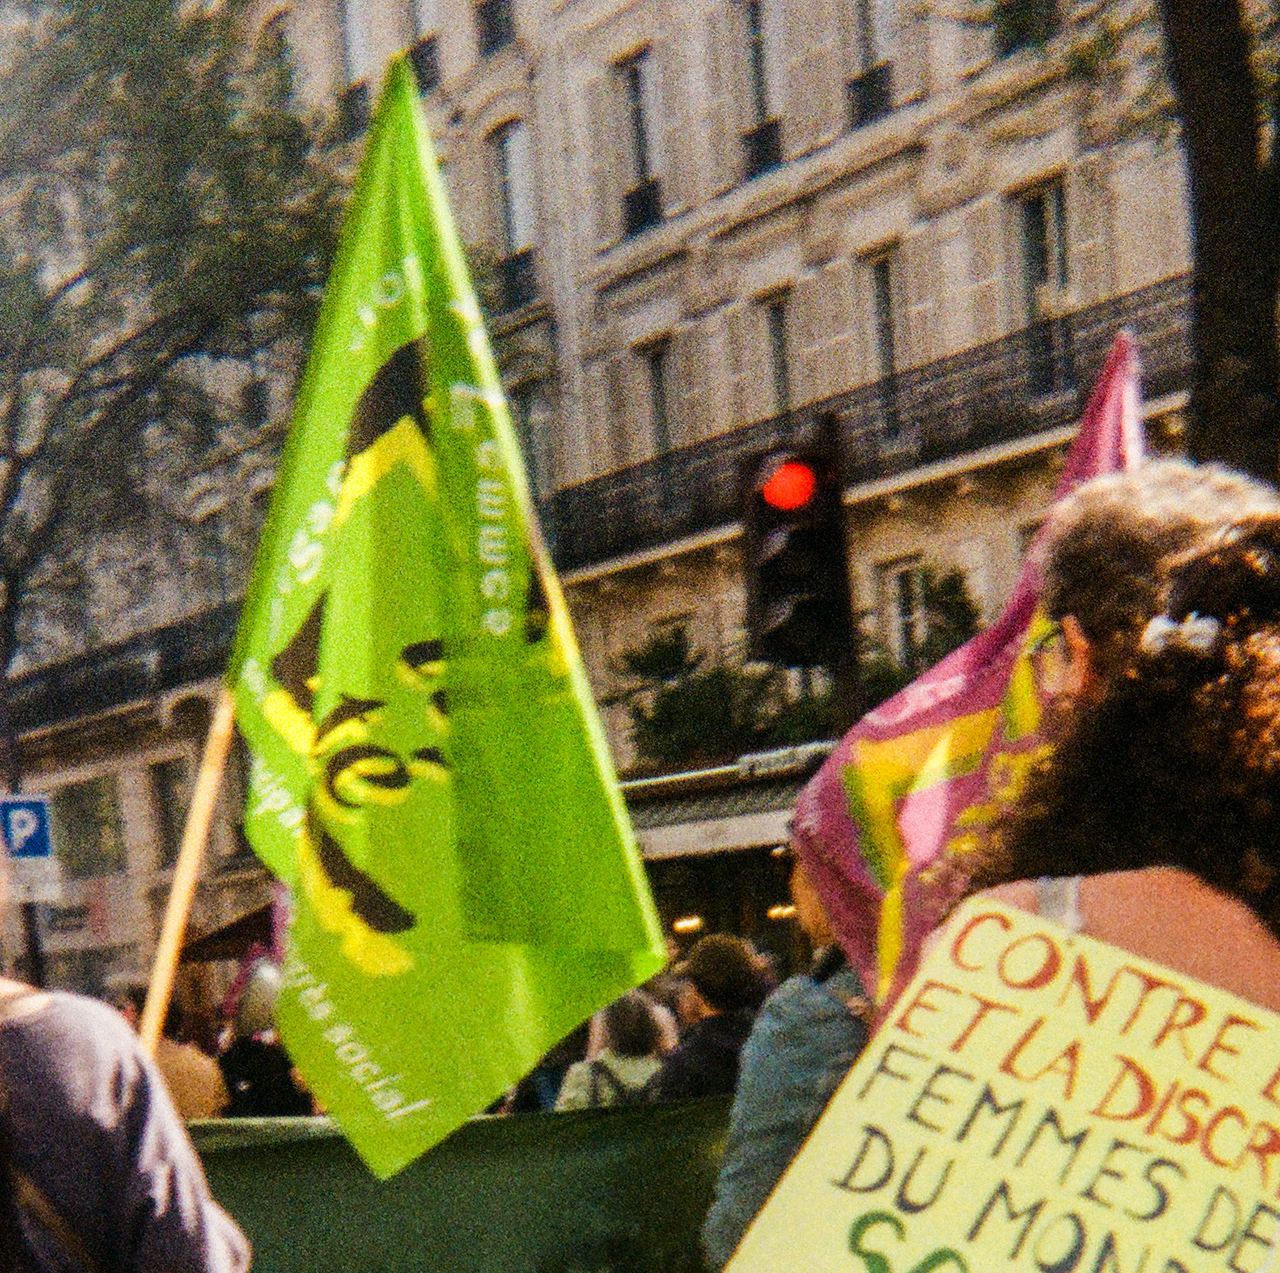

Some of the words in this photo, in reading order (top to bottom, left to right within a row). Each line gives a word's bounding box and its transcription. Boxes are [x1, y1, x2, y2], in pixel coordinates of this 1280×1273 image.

[8, 808, 37, 851] P
[895, 981, 1019, 1053] ET
[999, 1017, 1080, 1102] LA
[951, 912, 1262, 1077] CONTRE
[829, 1124, 955, 1215] DU
[857, 1044, 1190, 1222] FEMMES
